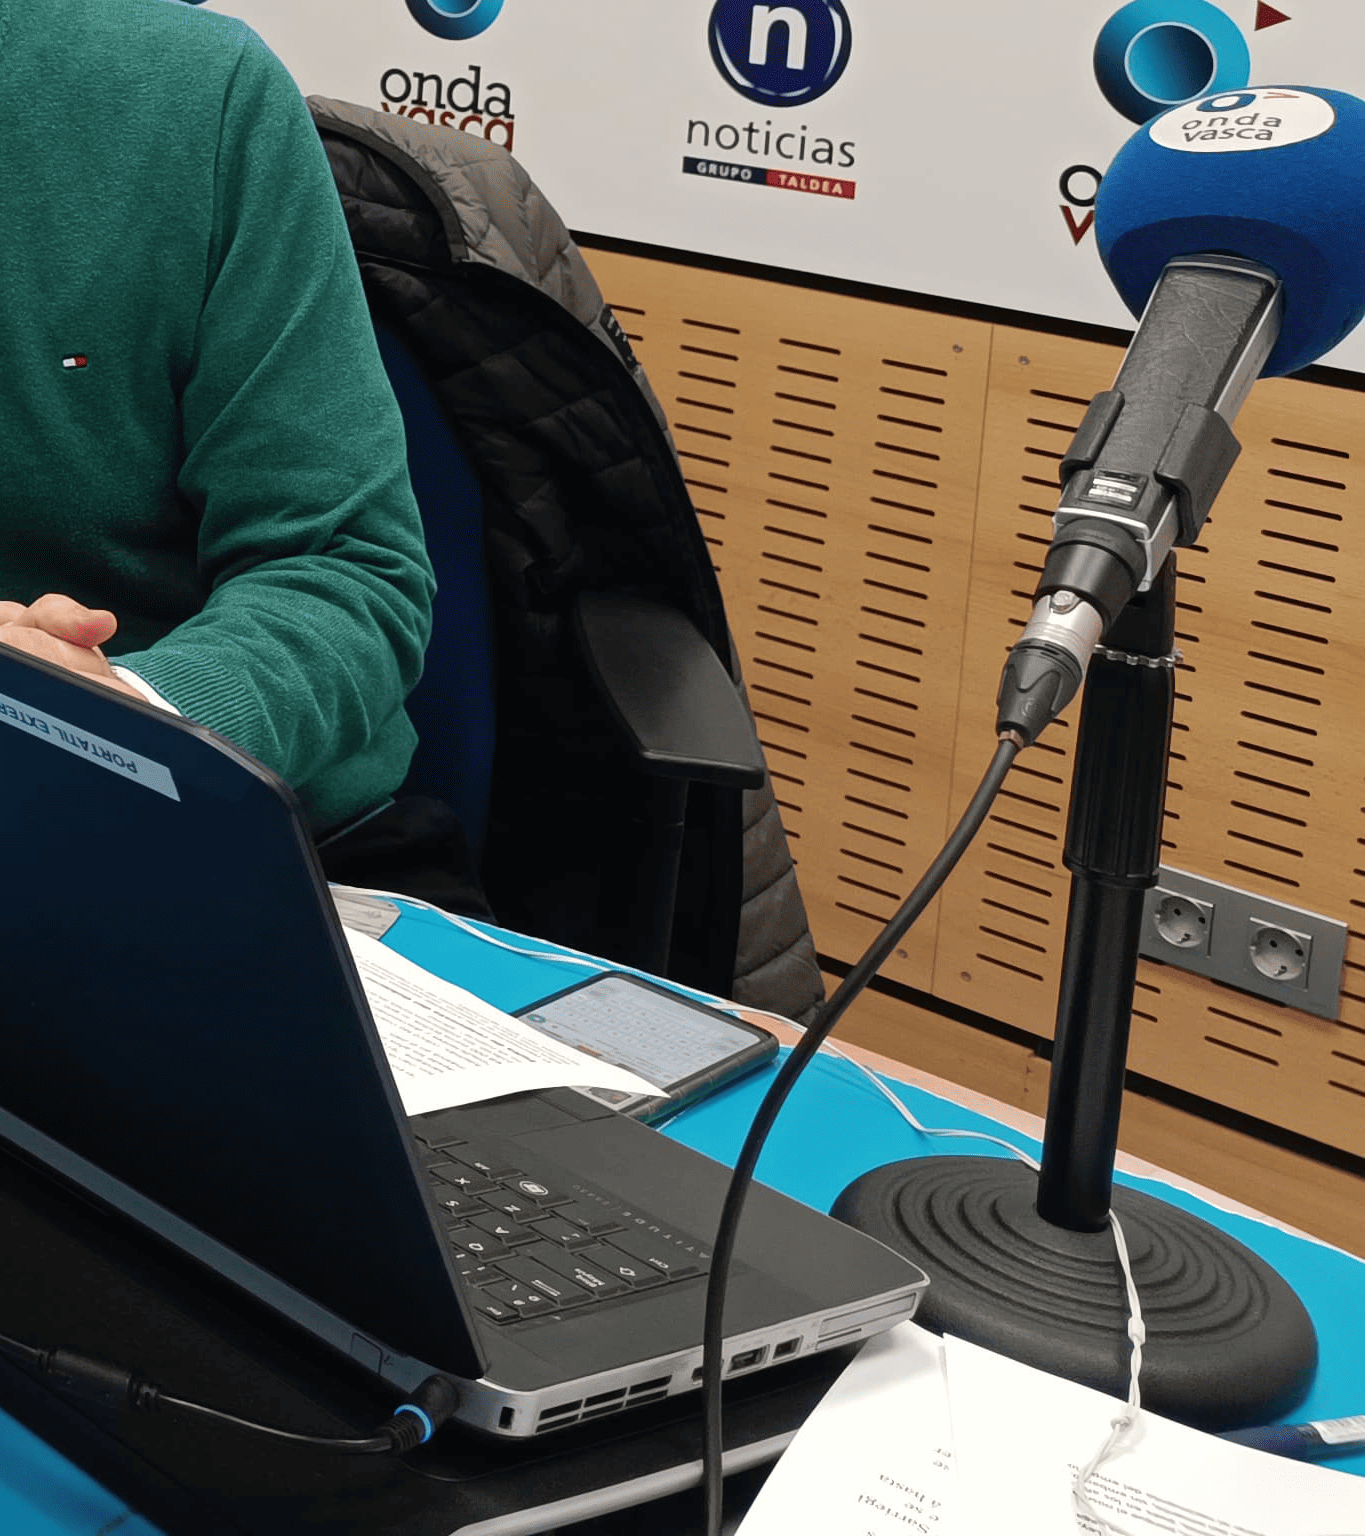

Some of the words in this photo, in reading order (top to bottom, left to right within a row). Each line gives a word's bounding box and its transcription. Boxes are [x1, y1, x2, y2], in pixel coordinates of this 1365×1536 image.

[380, 64, 515, 120] onda
[1181, 113, 1282, 130] onda
[1184, 126, 1274, 143] vasca
[686, 119, 857, 169] noticias
[696, 161, 753, 182] GRUPO
[777, 173, 844, 196] TALDEA
[51, 724, 139, 774] PORTATIL
